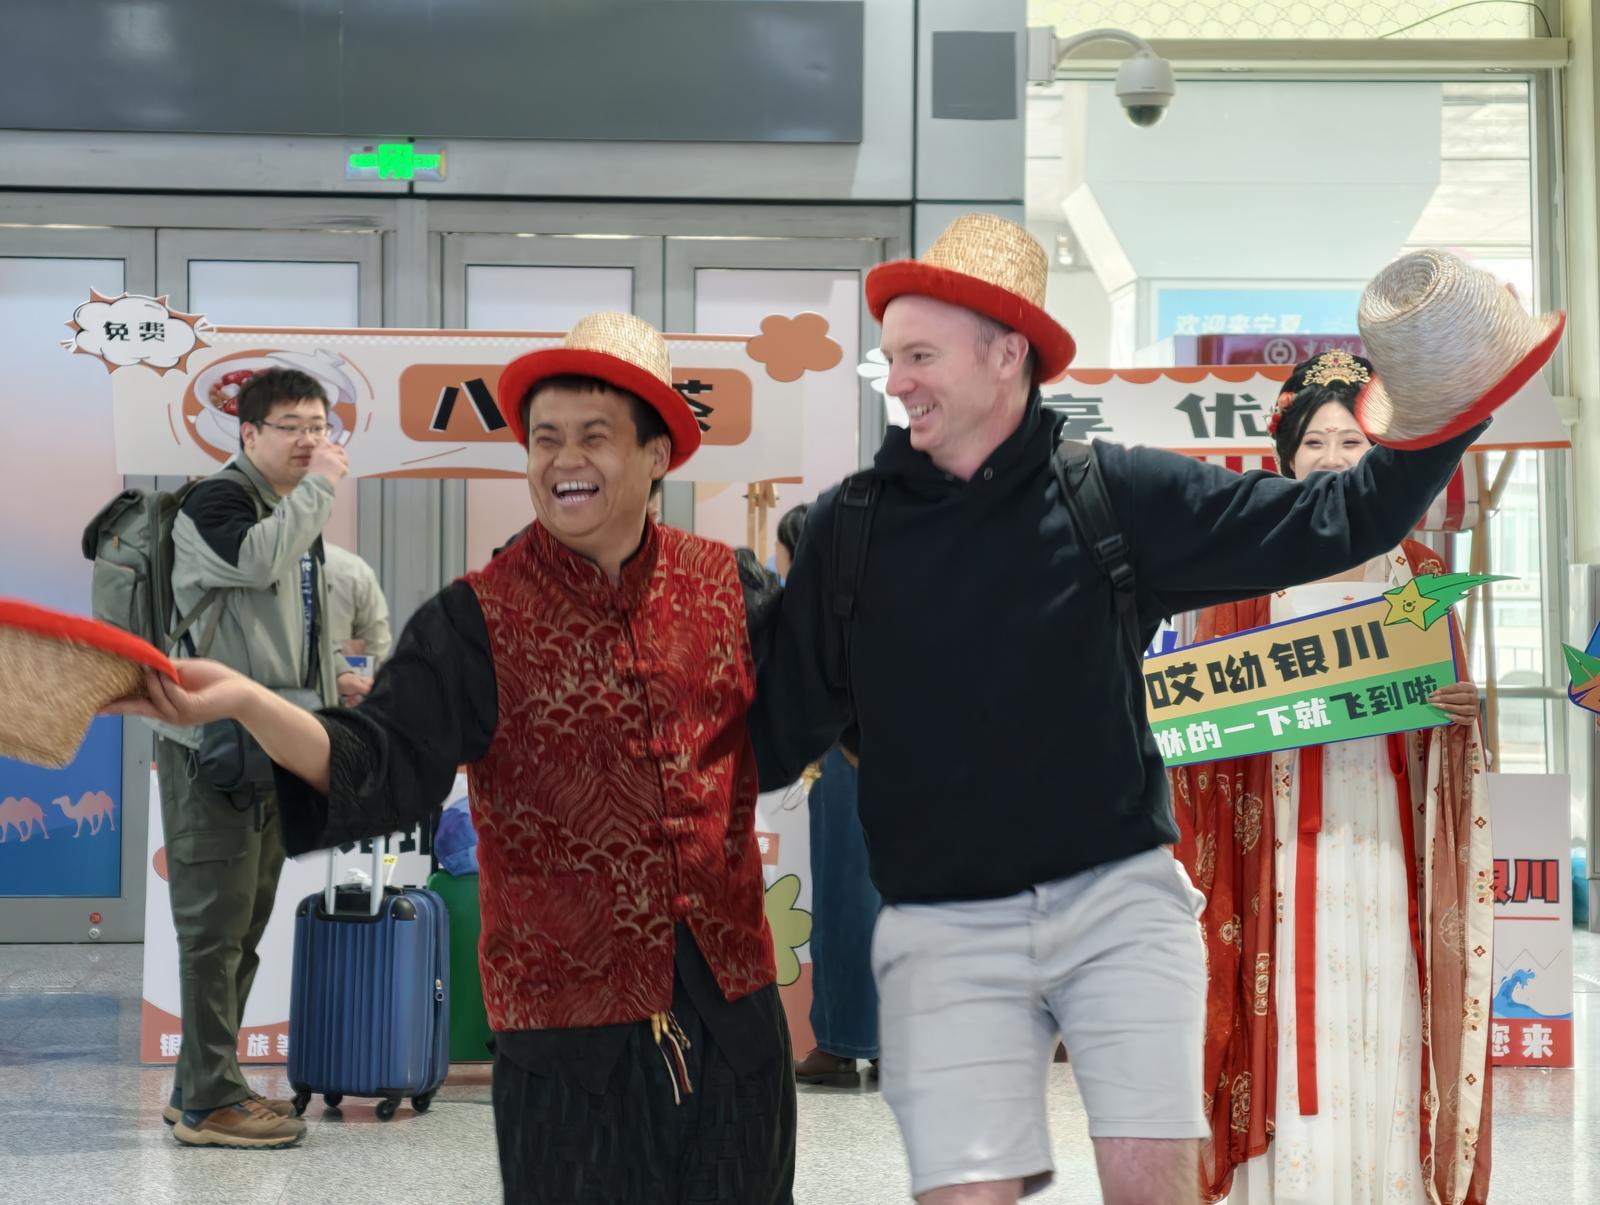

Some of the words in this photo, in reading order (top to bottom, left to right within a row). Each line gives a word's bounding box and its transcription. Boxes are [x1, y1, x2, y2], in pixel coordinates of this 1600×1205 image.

[103, 320, 165, 342] 免费
[1145, 620, 1390, 710] 哎呦银川
